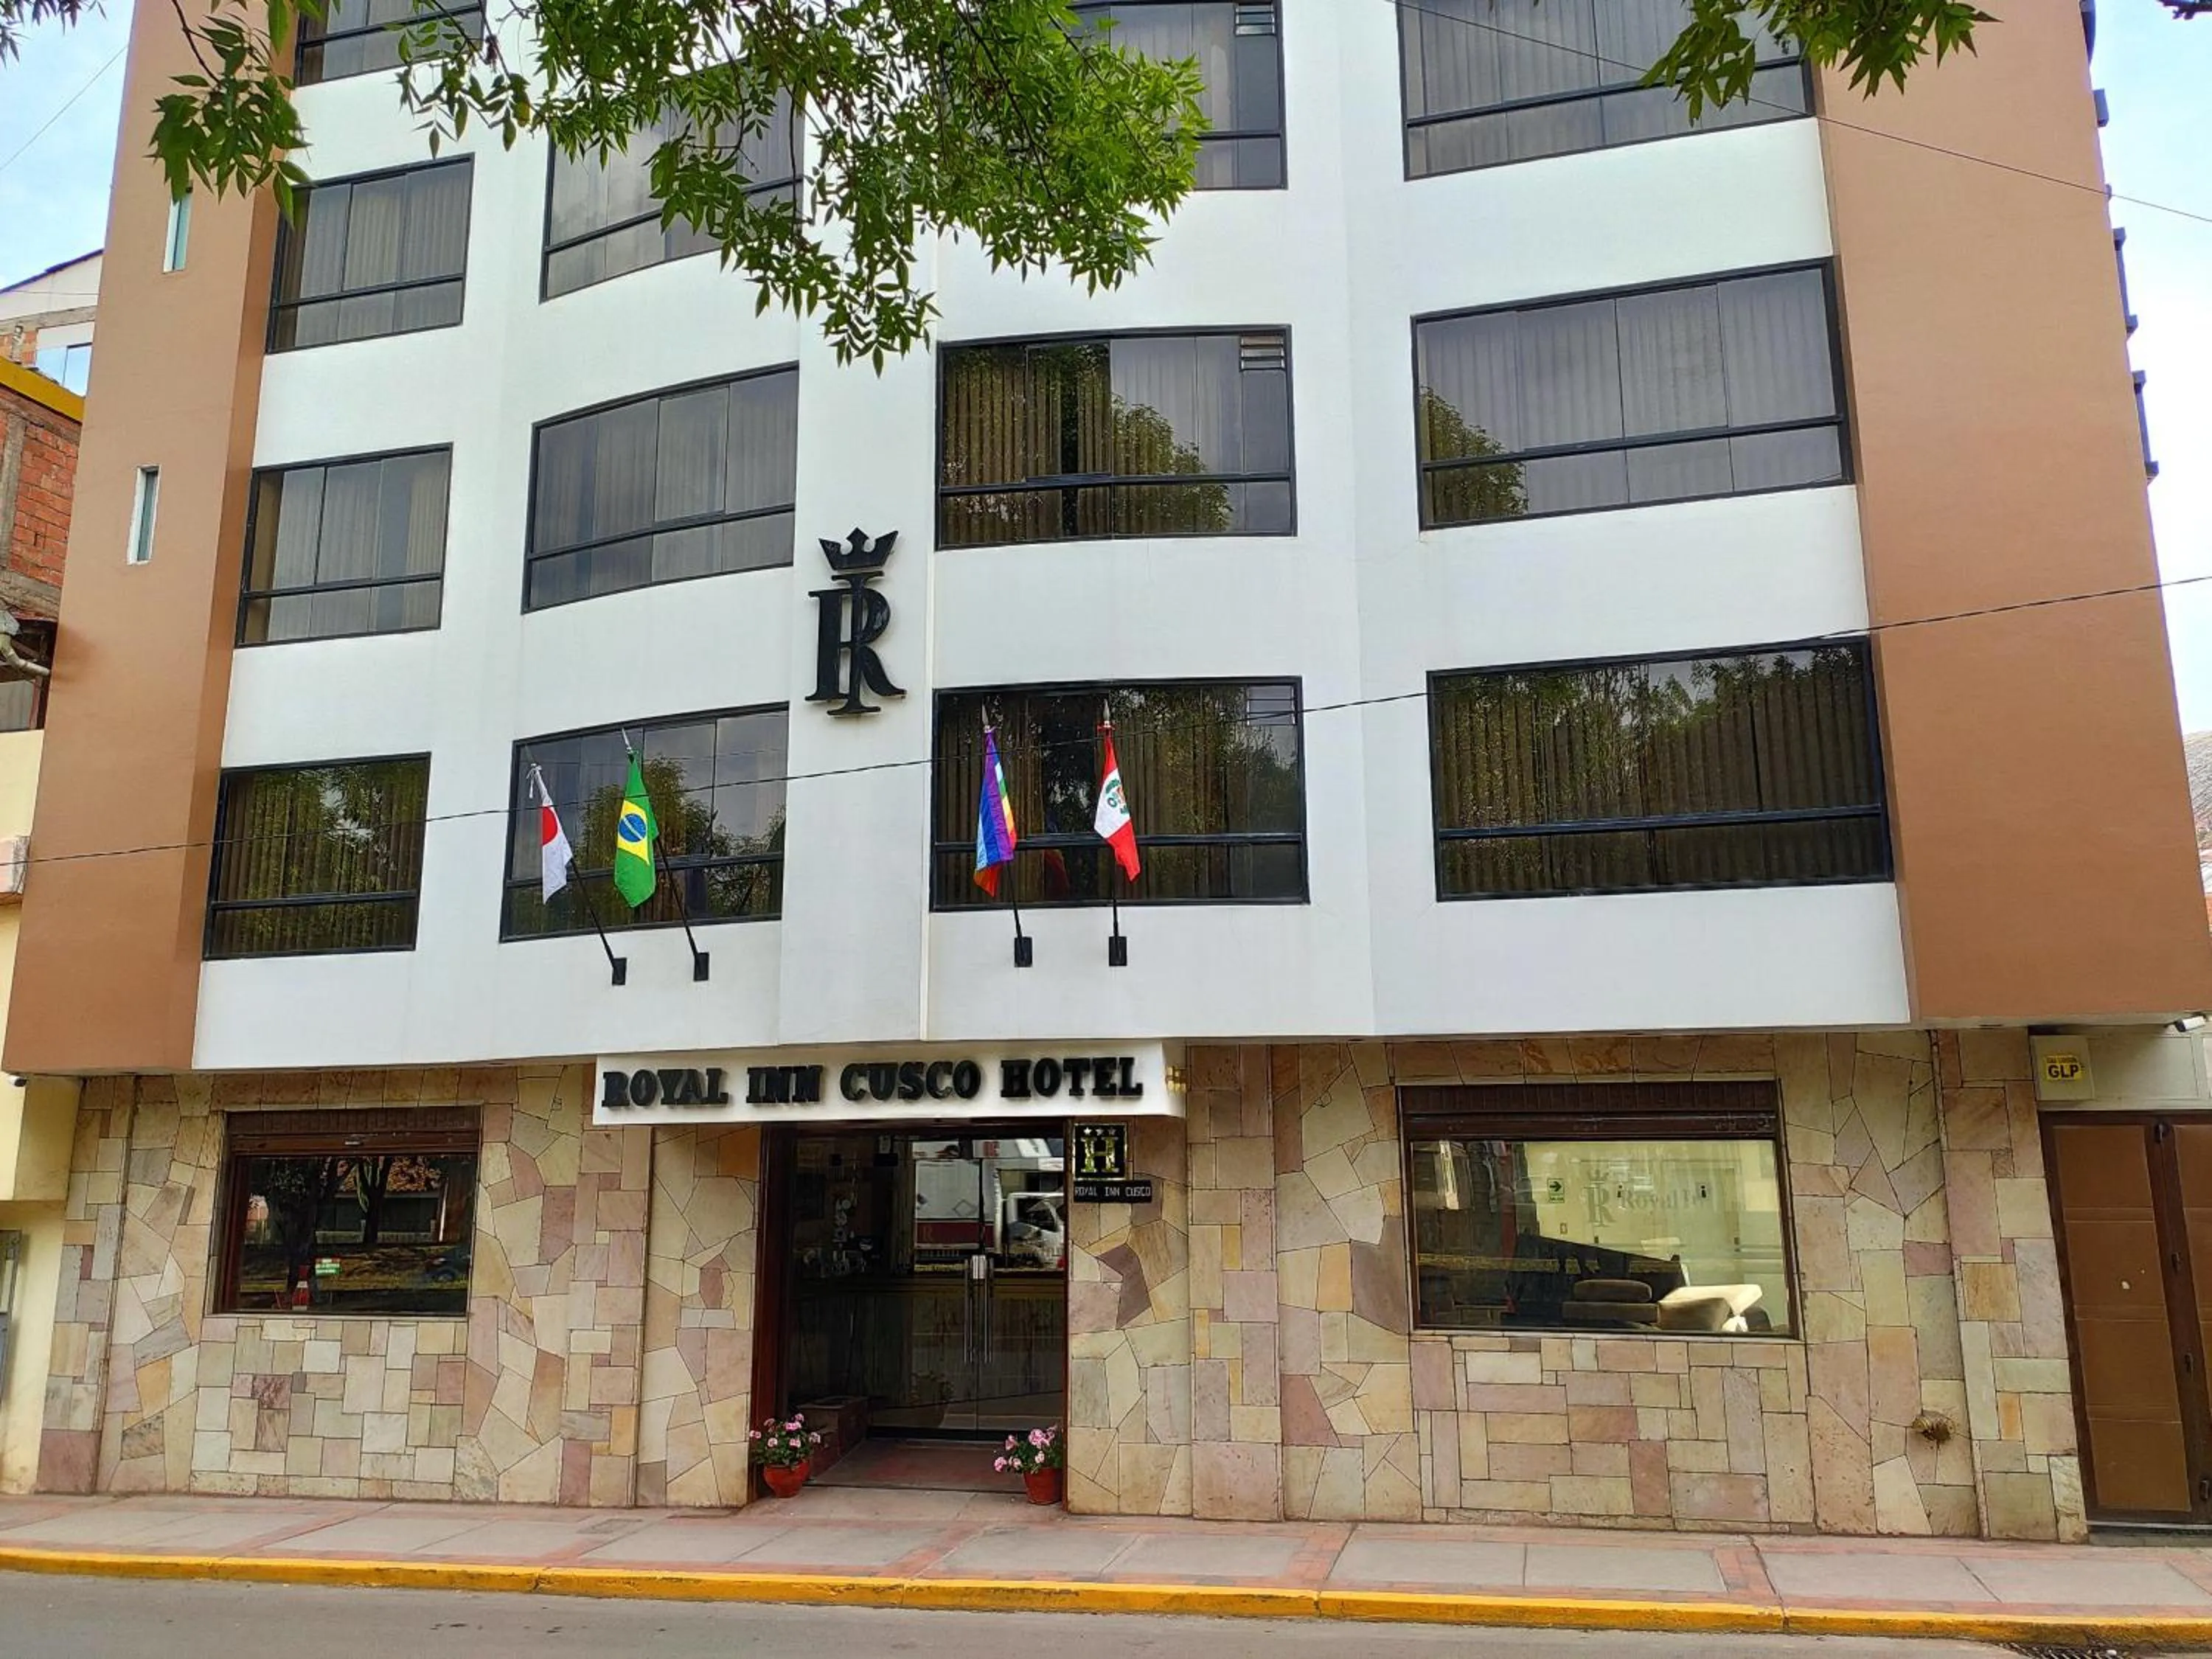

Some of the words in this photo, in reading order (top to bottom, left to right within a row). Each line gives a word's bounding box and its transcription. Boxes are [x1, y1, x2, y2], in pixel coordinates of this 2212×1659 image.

[601, 1068, 728, 1107] ROYAL
[746, 1064, 824, 1103] INN
[840, 1060, 981, 1101] CUSCO
[1001, 1057, 1143, 1097] HOTEL
[2048, 1064, 2079, 1078] GLP
[1080, 1136, 1119, 1172] H
[1074, 1186, 1097, 1196] ROYAL
[1105, 1186, 1120, 1196] INN
[1124, 1186, 1151, 1197] CUSCO
